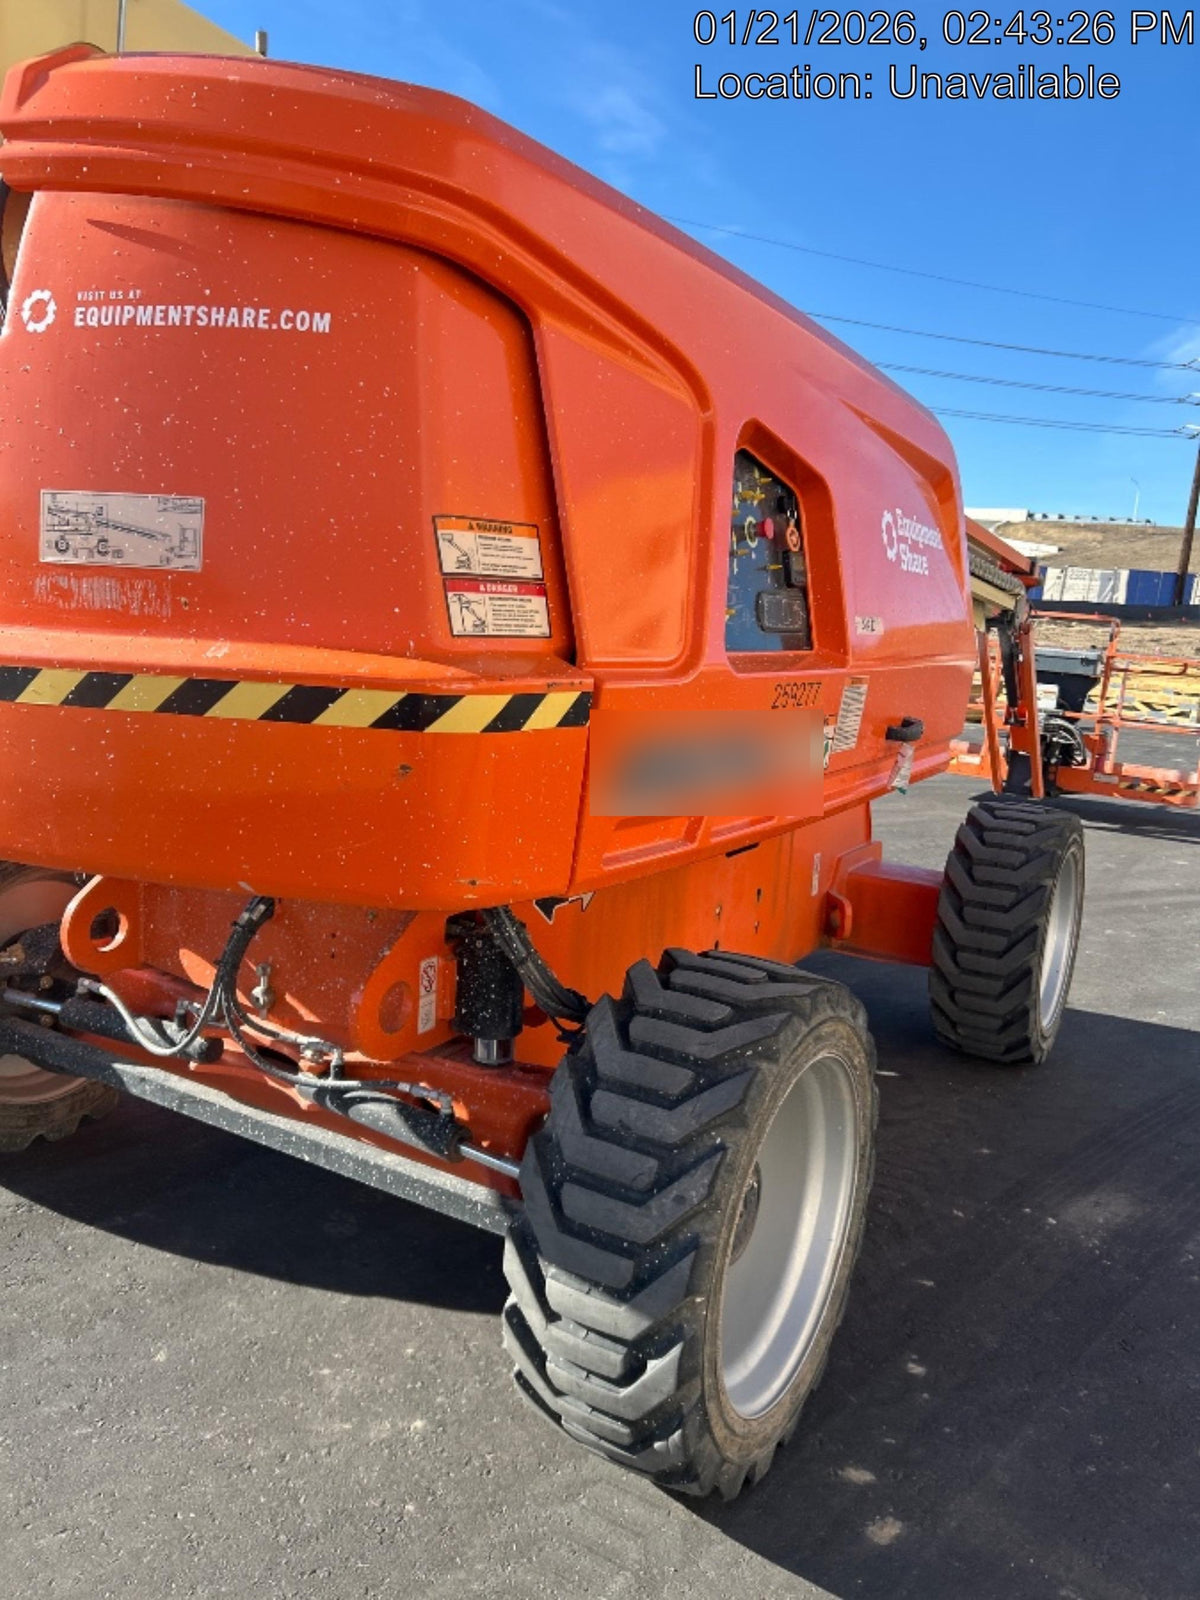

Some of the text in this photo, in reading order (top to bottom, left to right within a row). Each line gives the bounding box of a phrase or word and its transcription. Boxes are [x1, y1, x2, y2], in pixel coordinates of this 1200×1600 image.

[77, 289, 142, 301] VISIT US AT
[74, 304, 332, 334] EQUIPMENTSHARE.COM
[899, 543, 929, 577] Share
